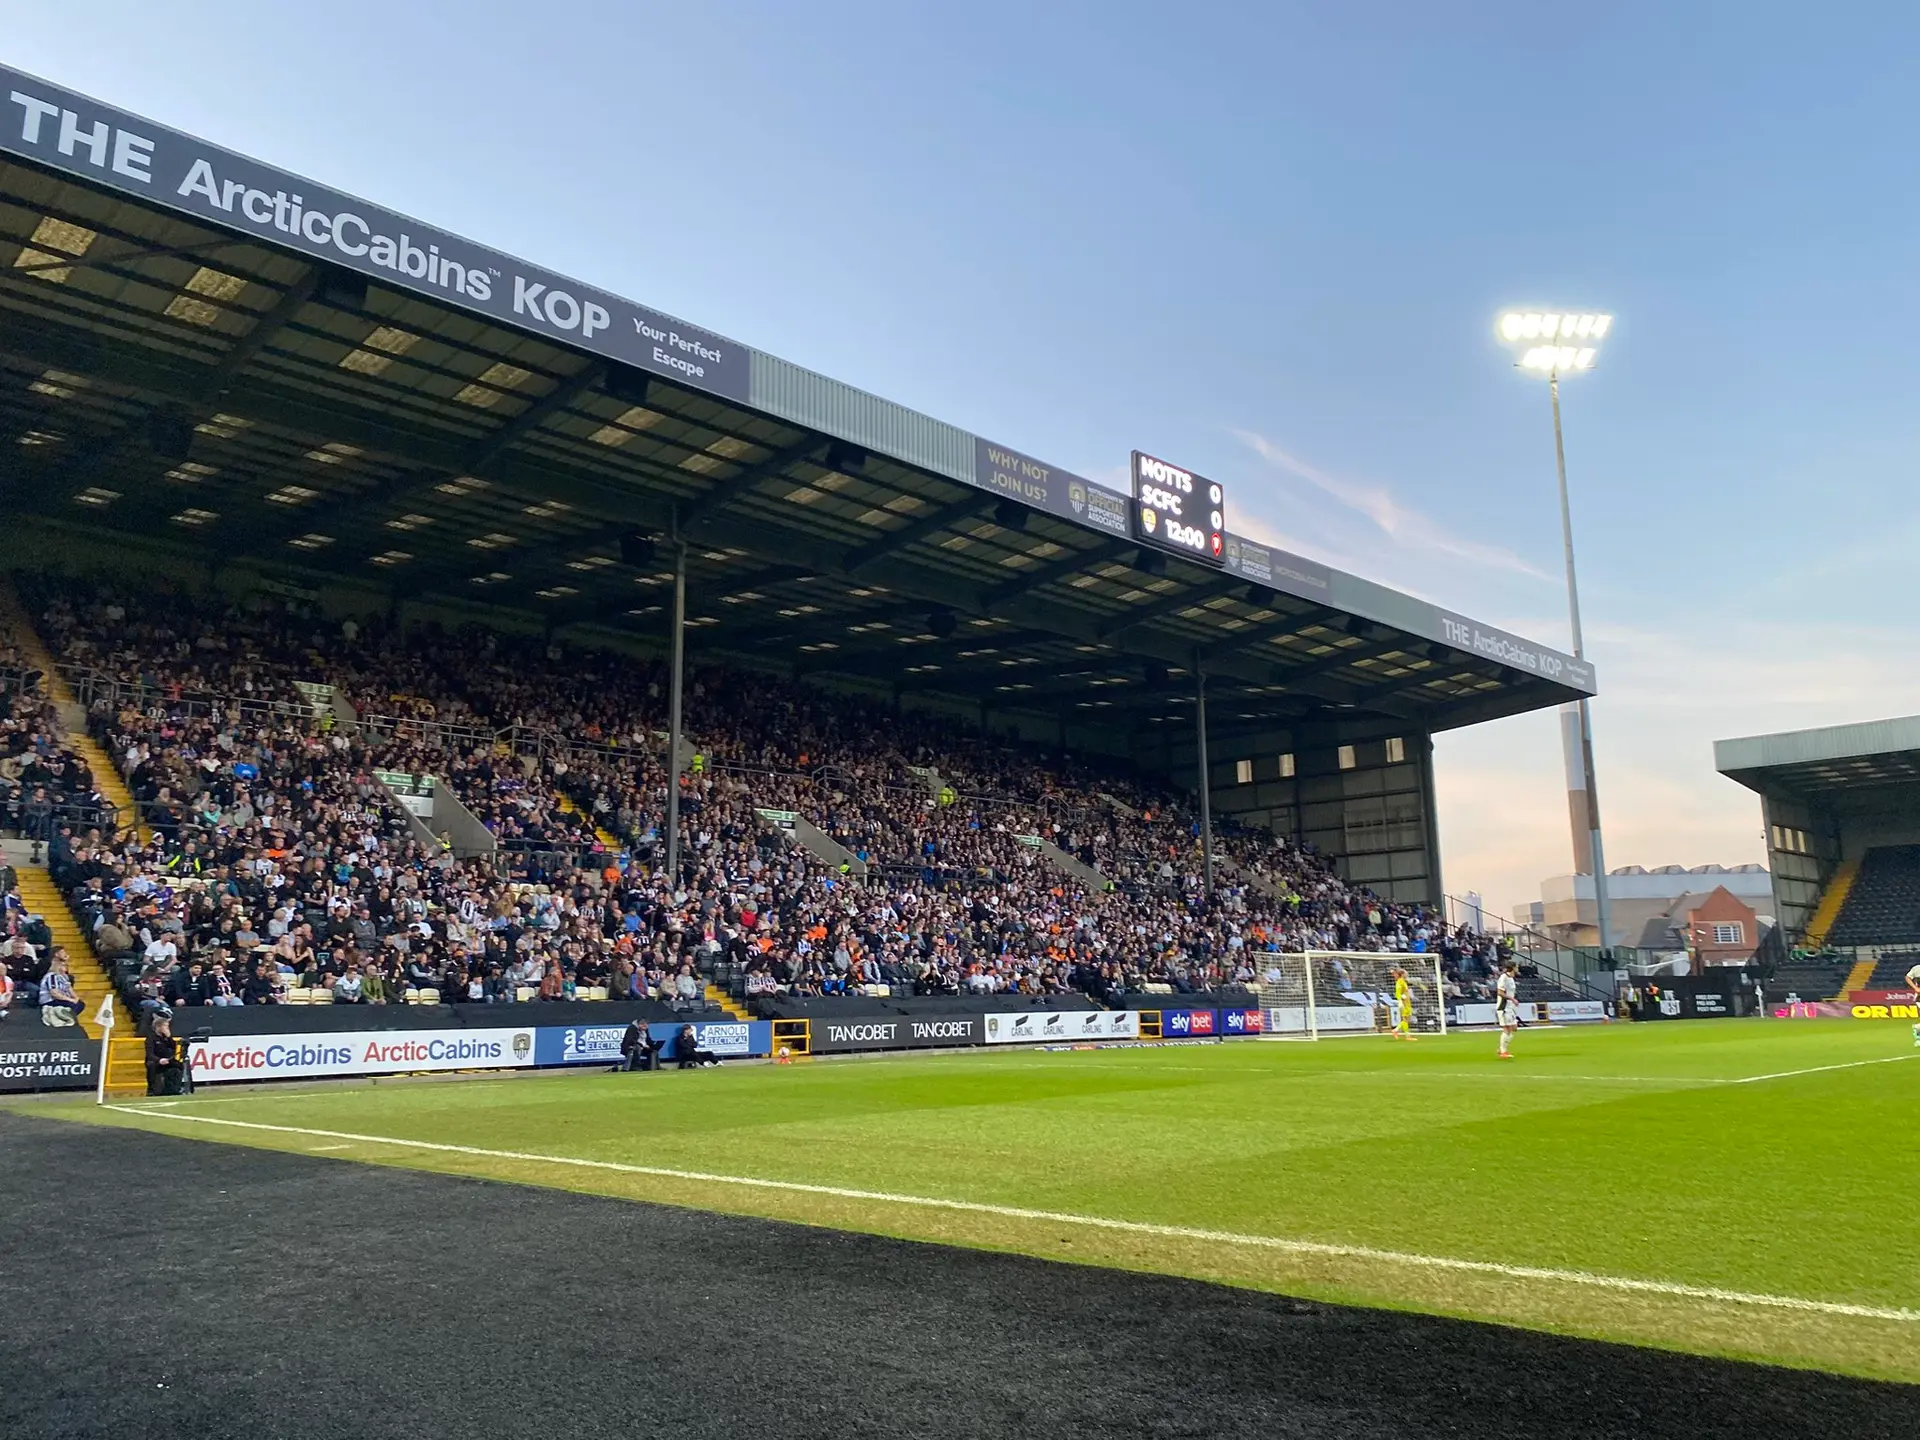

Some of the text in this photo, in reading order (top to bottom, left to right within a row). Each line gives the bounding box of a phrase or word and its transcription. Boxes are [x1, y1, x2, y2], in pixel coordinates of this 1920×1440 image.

[10, 90, 155, 184] THE
[513, 275, 611, 339] KOP
[632, 317, 722, 364] Your Perfect
[652, 346, 705, 377] Escape
[988, 447, 1049, 483] WHY NOT
[1141, 455, 1193, 493] NOTTS
[989, 471, 1048, 502] JOIN US?
[1141, 484, 1183, 515] SCFC
[1165, 518, 1205, 550] 12:00
[1442, 618, 1471, 646] THE
[1538, 652, 1562, 677] KOP
[1227, 1011, 1264, 1030] sky bet
[1851, 1004, 1890, 1019] OR
[707, 1026, 747, 1036] ARNOLD
[911, 1021, 973, 1038] TANGOBET
[1011, 1026, 1033, 1036] CARLING
[1043, 1025, 1064, 1035] CARLING
[1082, 1024, 1102, 1034] CARLING
[1110, 1023, 1130, 1033] CARLING
[1171, 1012, 1211, 1032] sky bet
[587, 1029, 625, 1041] ARNOL
[707, 1036, 747, 1044] ELECTRICAL
[827, 1023, 898, 1042] TANGOBET
[0, 1051, 79, 1064] ENTRY PRE
[190, 1038, 502, 1071] ArcticCabins ArcticCabins
[0, 1063, 92, 1078] OST-MATCH
